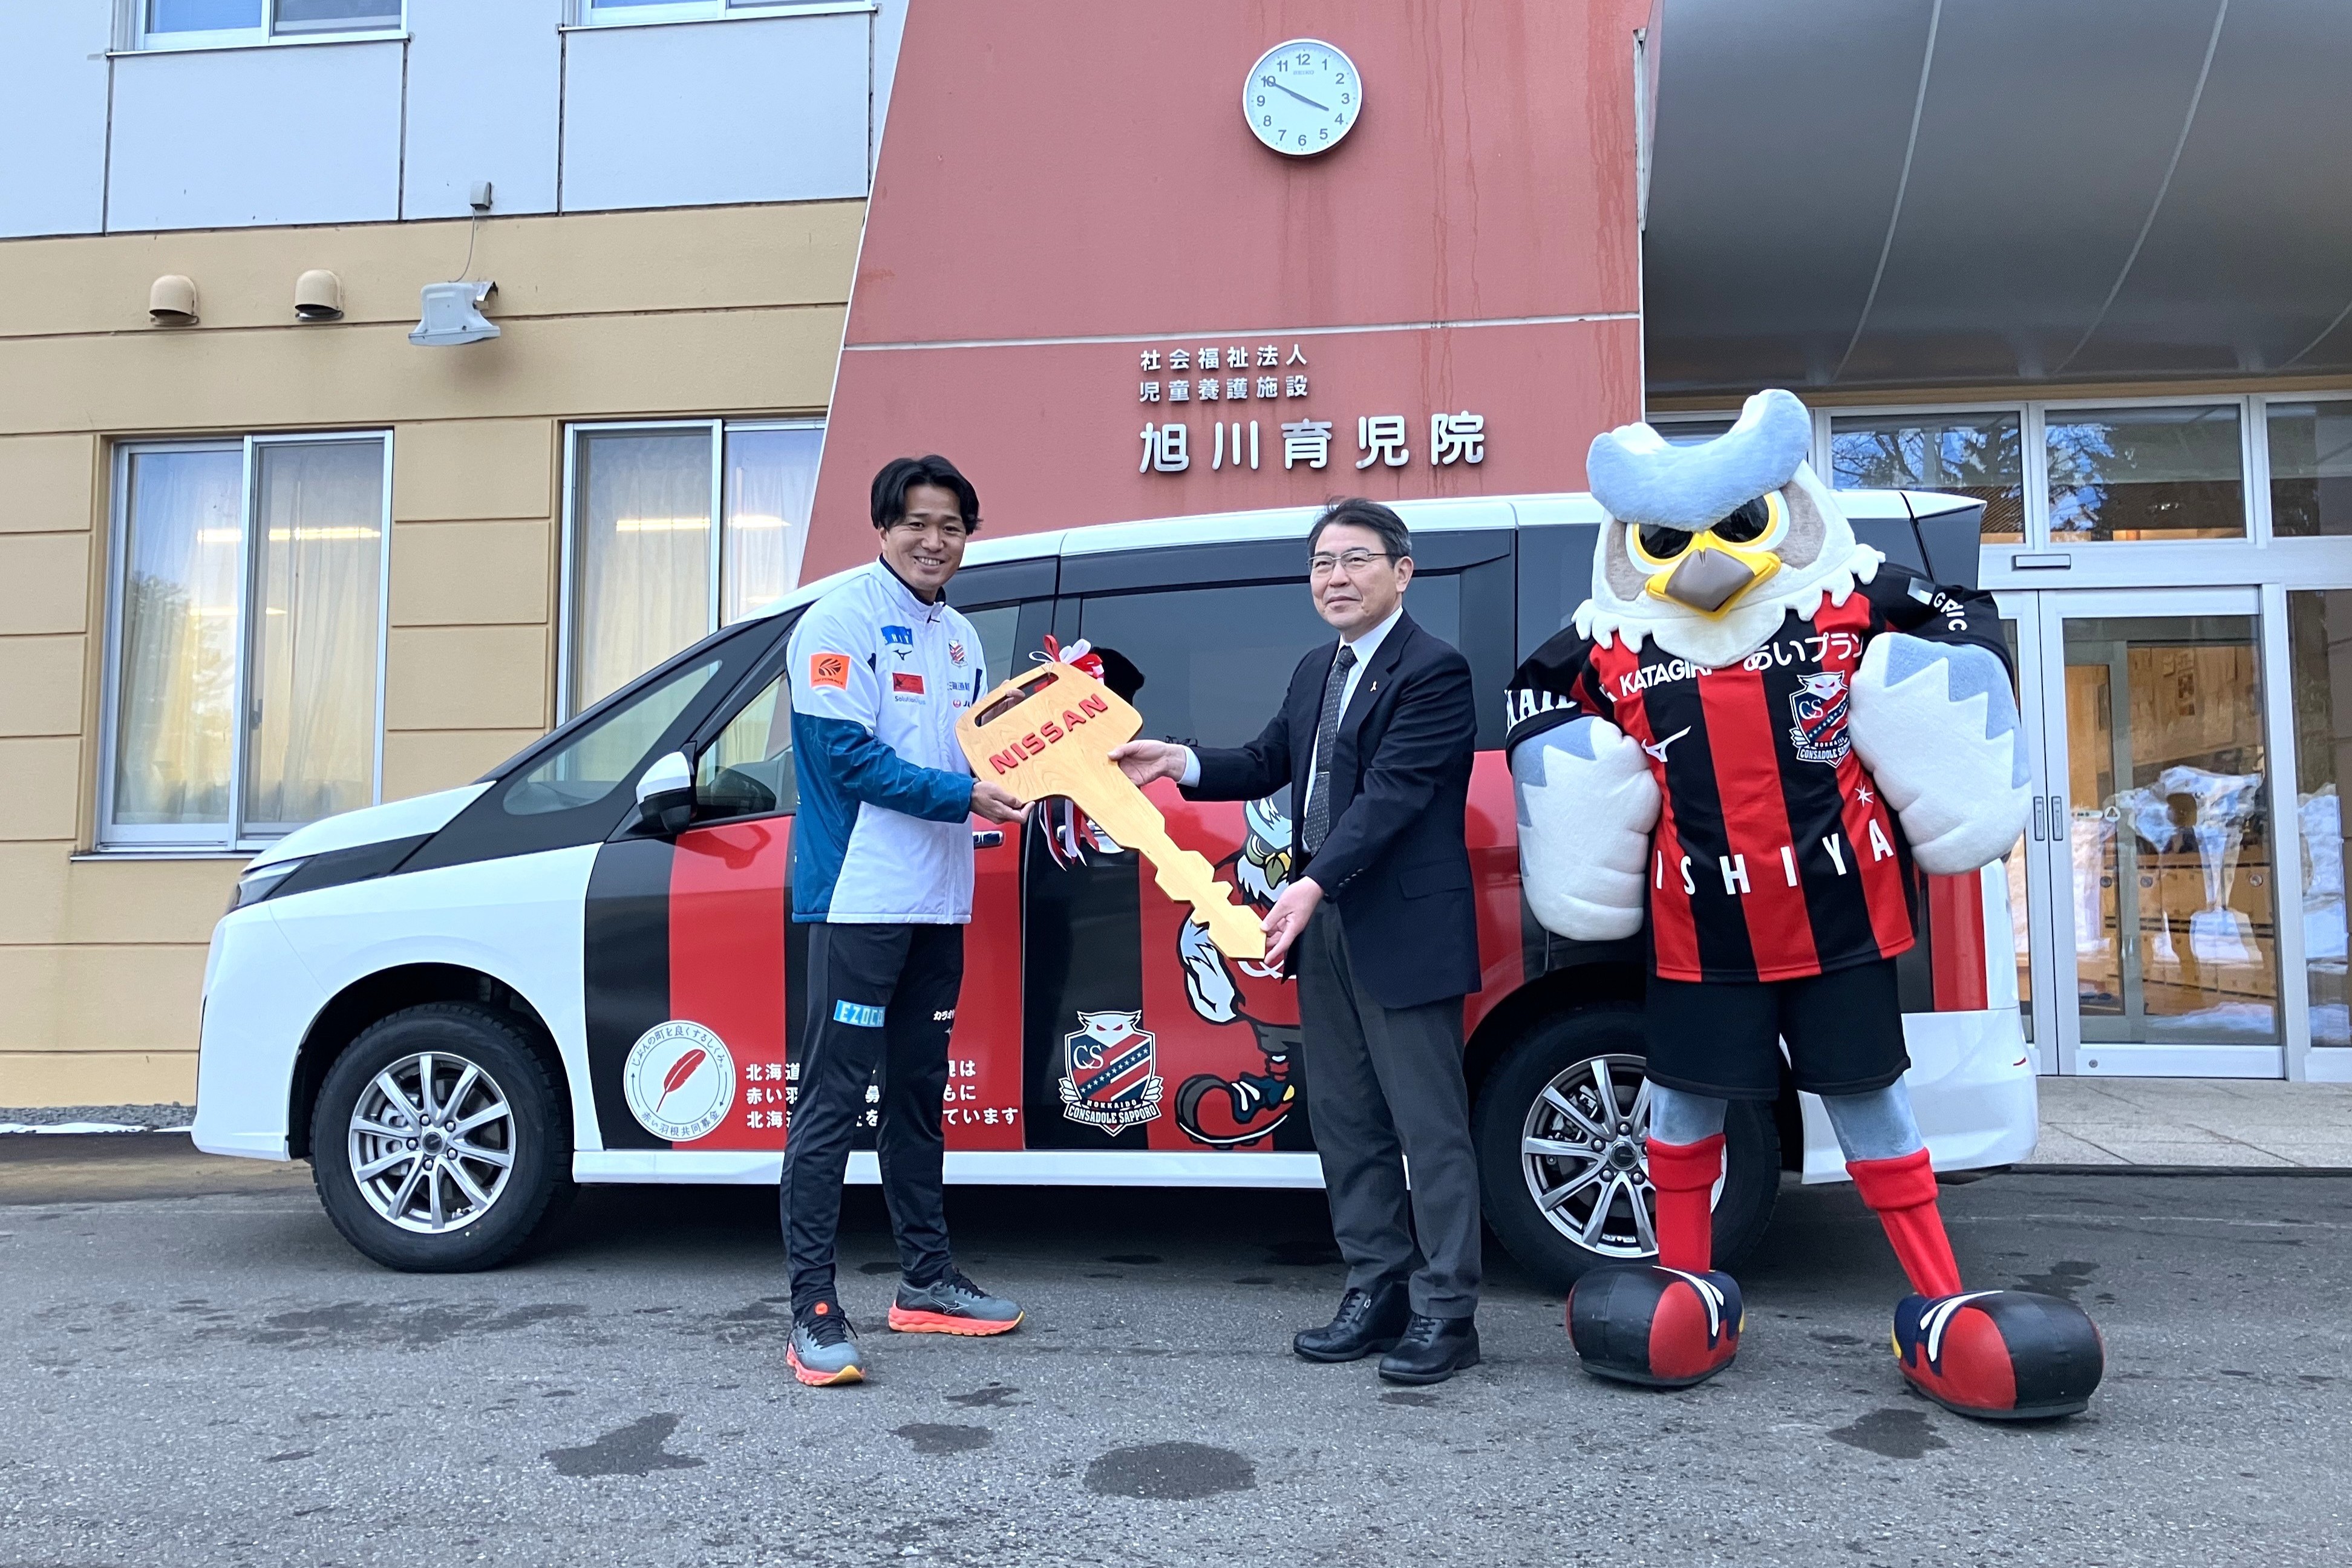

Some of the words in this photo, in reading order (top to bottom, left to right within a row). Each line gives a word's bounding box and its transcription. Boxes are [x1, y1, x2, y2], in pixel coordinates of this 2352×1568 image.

[1296, 53, 1310, 65] 12
[1322, 58, 1327, 70] 1
[1276, 60, 1288, 72] 11
[1260, 76, 1276, 87] 10
[1335, 73, 1345, 84] 2
[1256, 95, 1266, 106] 9
[1341, 93, 1350, 104] 3
[1263, 115, 1272, 126] 8
[1334, 113, 1344, 125] 4
[1278, 129, 1287, 141] 7
[1298, 134, 1307, 146] 6
[1319, 128, 1328, 140] 5
[1140, 344, 1307, 371] 社会福祉法人
[1139, 374, 1308, 403] 児童養護施設
[1138, 410, 1485, 474] 旭川育児院
[1933, 592, 1968, 631] GRIC
[1798, 698, 1824, 720] CS
[989, 693, 1108, 775] NISSAN
[1800, 748, 1838, 760] CONSADOLE
[1655, 818, 1895, 895] ISHIYA
[840, 1002, 884, 1026] EZOCA
[1073, 1044, 1104, 1070] CS
[1086, 1099, 1137, 1109] HOKKAIDO
[942, 1108, 1018, 1125] ています
[1068, 1105, 1117, 1124] CONSADOLE
[1119, 1105, 1158, 1123] SAPPORO
[641, 1111, 720, 1137] 赤い羽根共同募金
